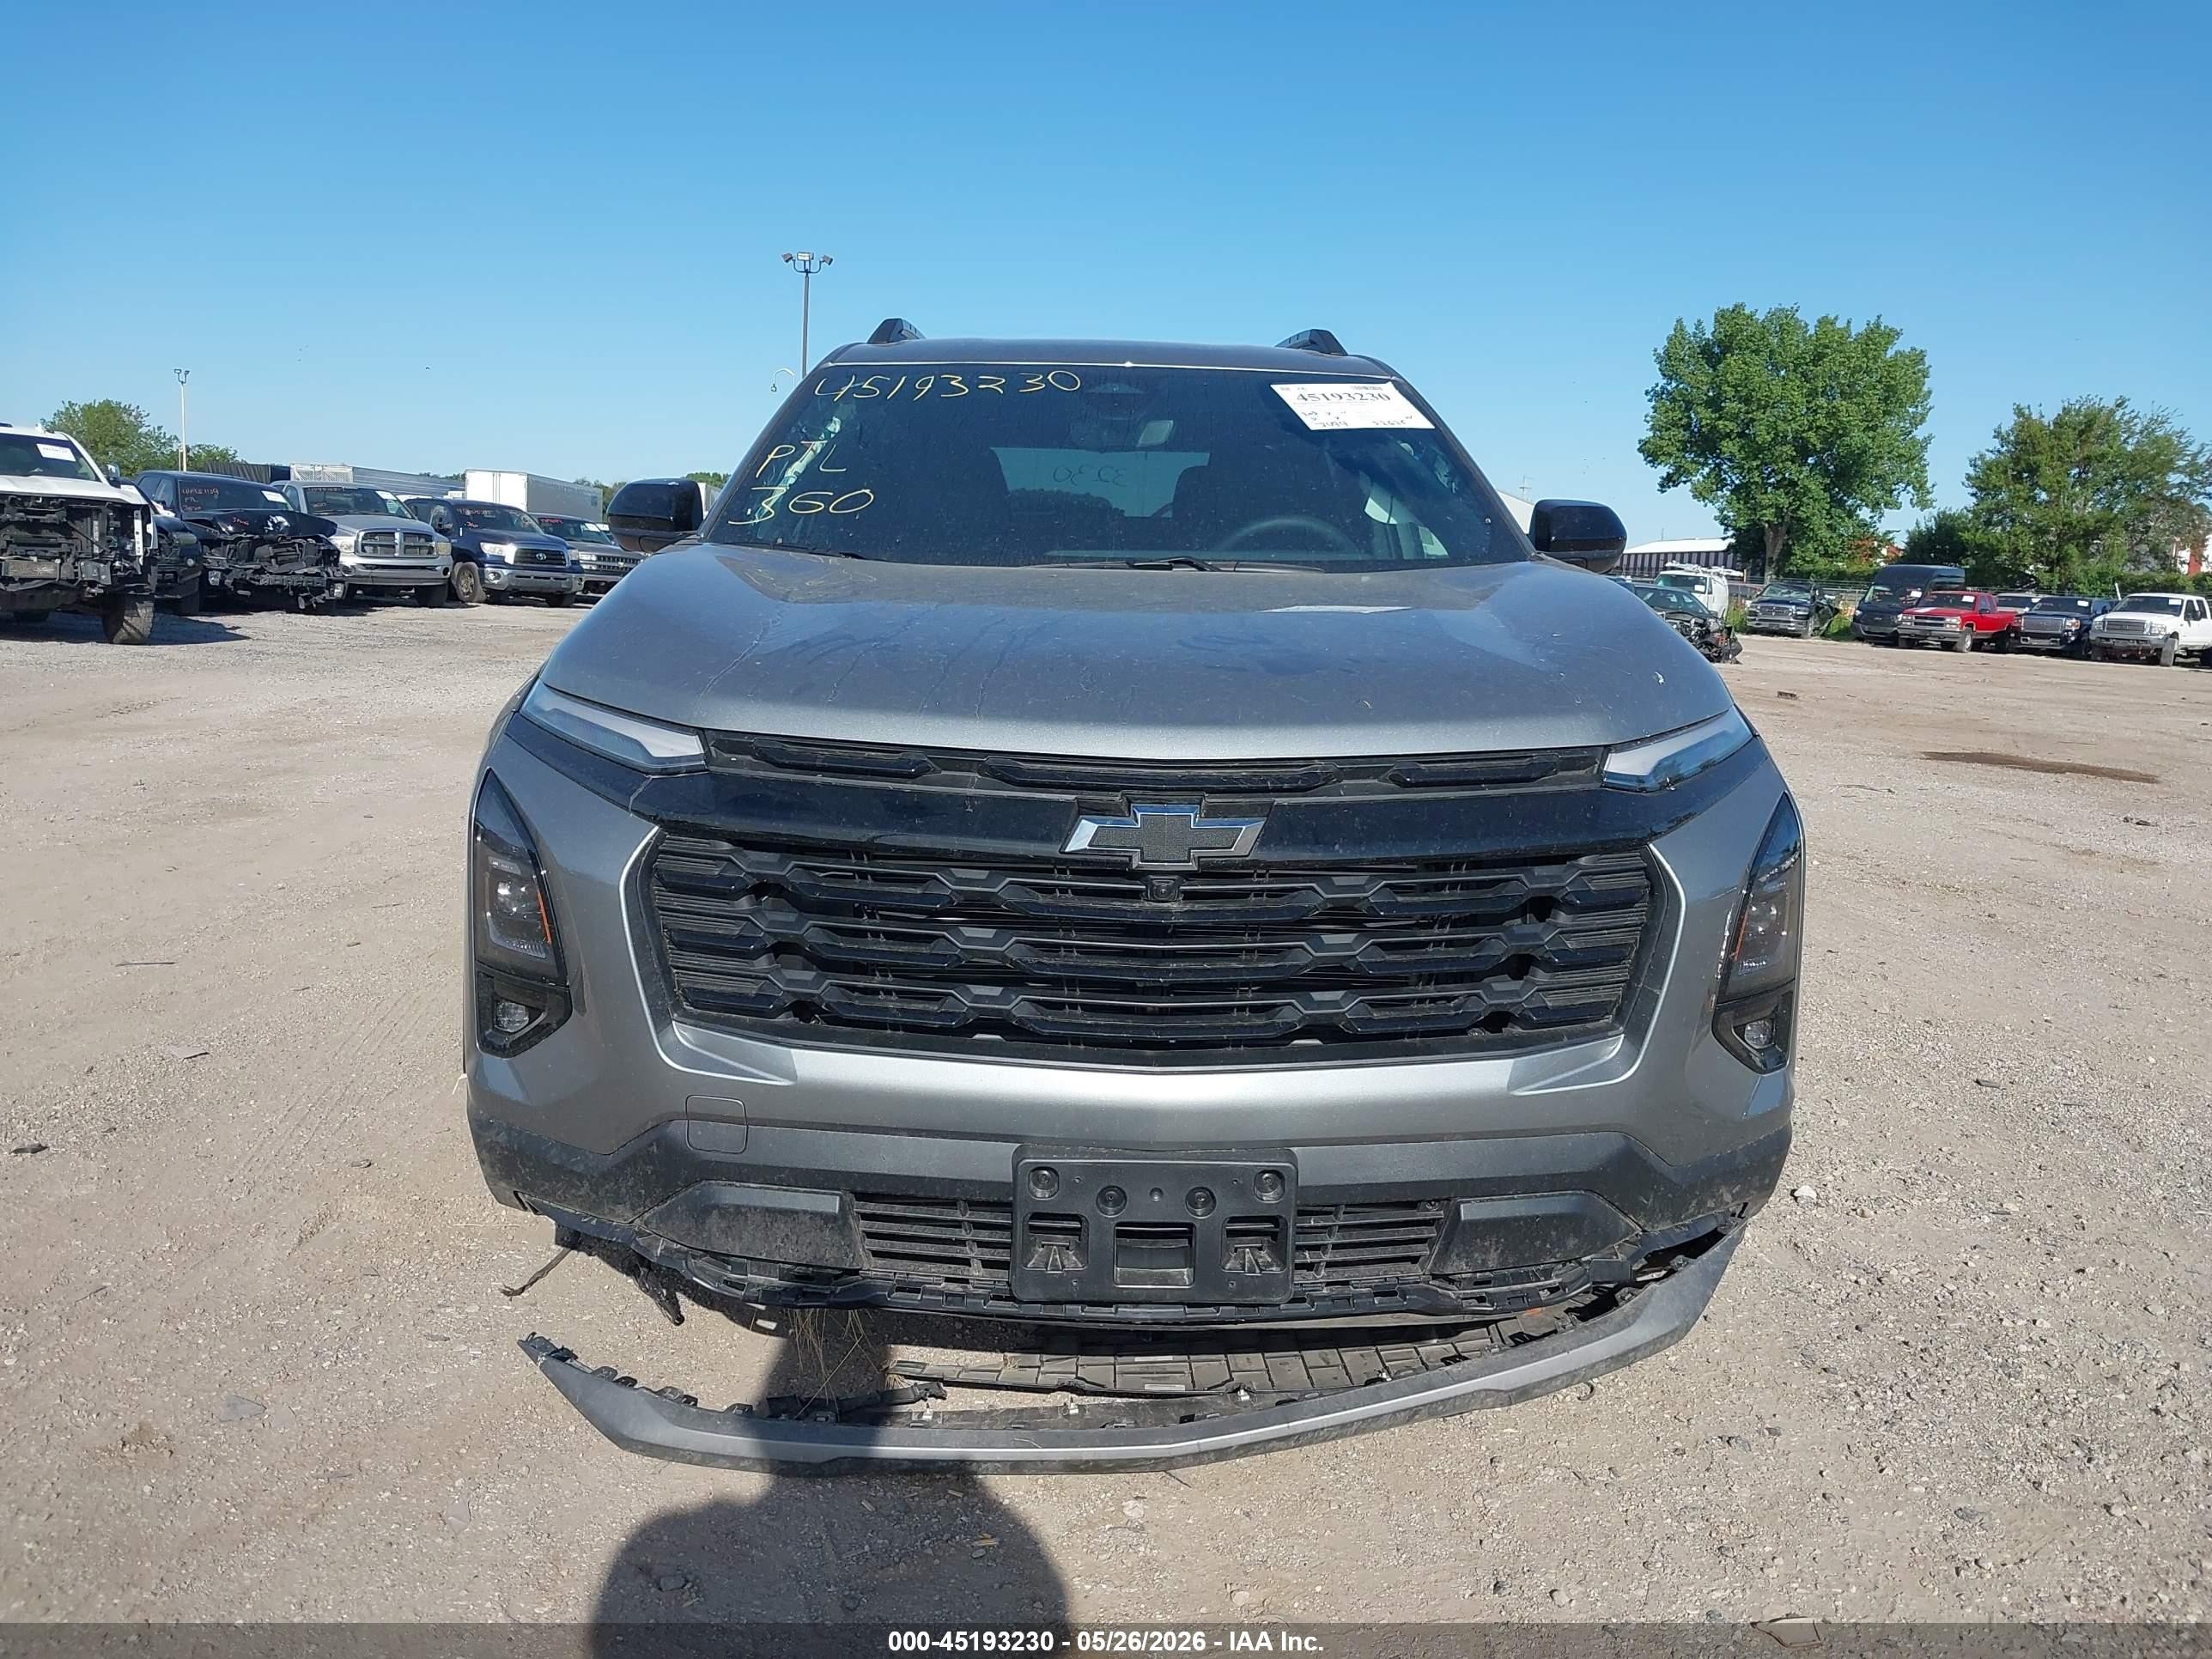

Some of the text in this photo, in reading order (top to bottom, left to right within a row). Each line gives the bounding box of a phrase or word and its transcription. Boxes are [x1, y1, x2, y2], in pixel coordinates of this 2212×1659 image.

[814, 370, 1081, 402] 45193230
[1296, 392, 1392, 402] 45193230
[727, 488, 875, 525] 360
